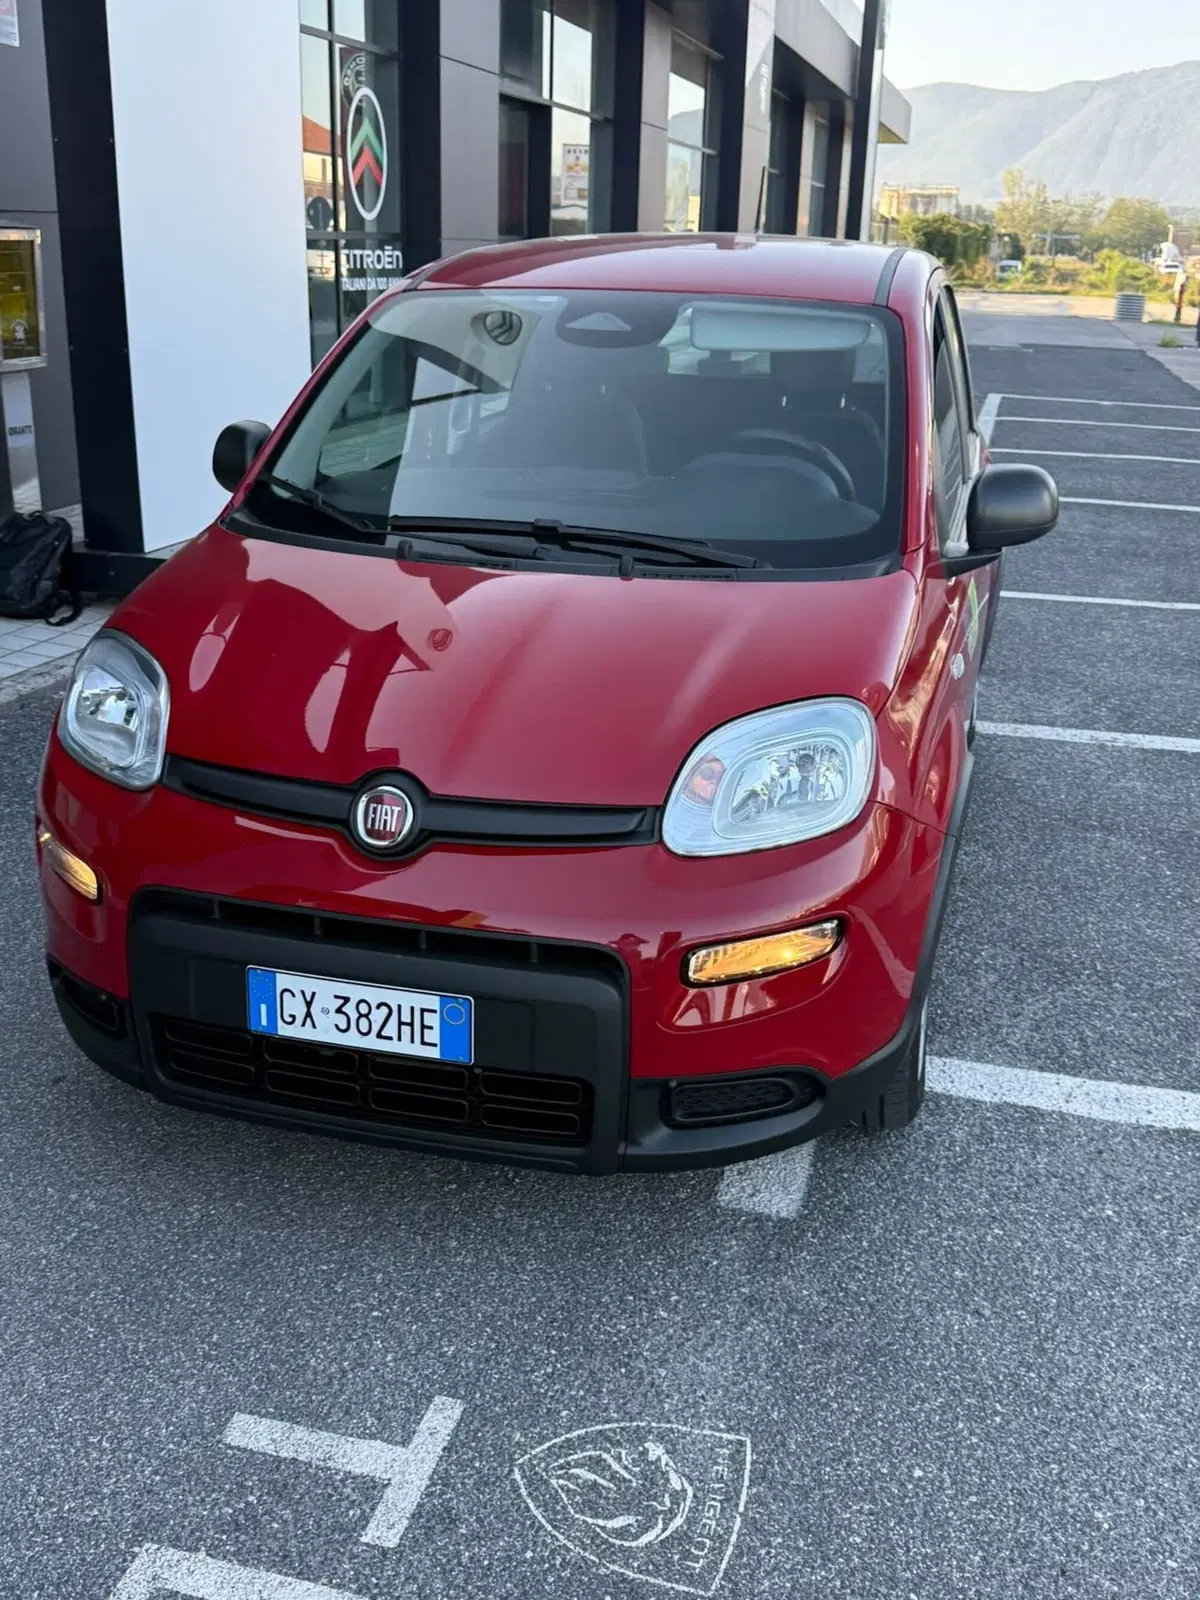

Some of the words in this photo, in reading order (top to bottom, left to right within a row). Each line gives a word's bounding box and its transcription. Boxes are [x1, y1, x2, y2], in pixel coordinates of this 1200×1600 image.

[367, 803, 402, 832] FIAT
[279, 988, 317, 1029] GX
[333, 994, 438, 1047] 382HE
